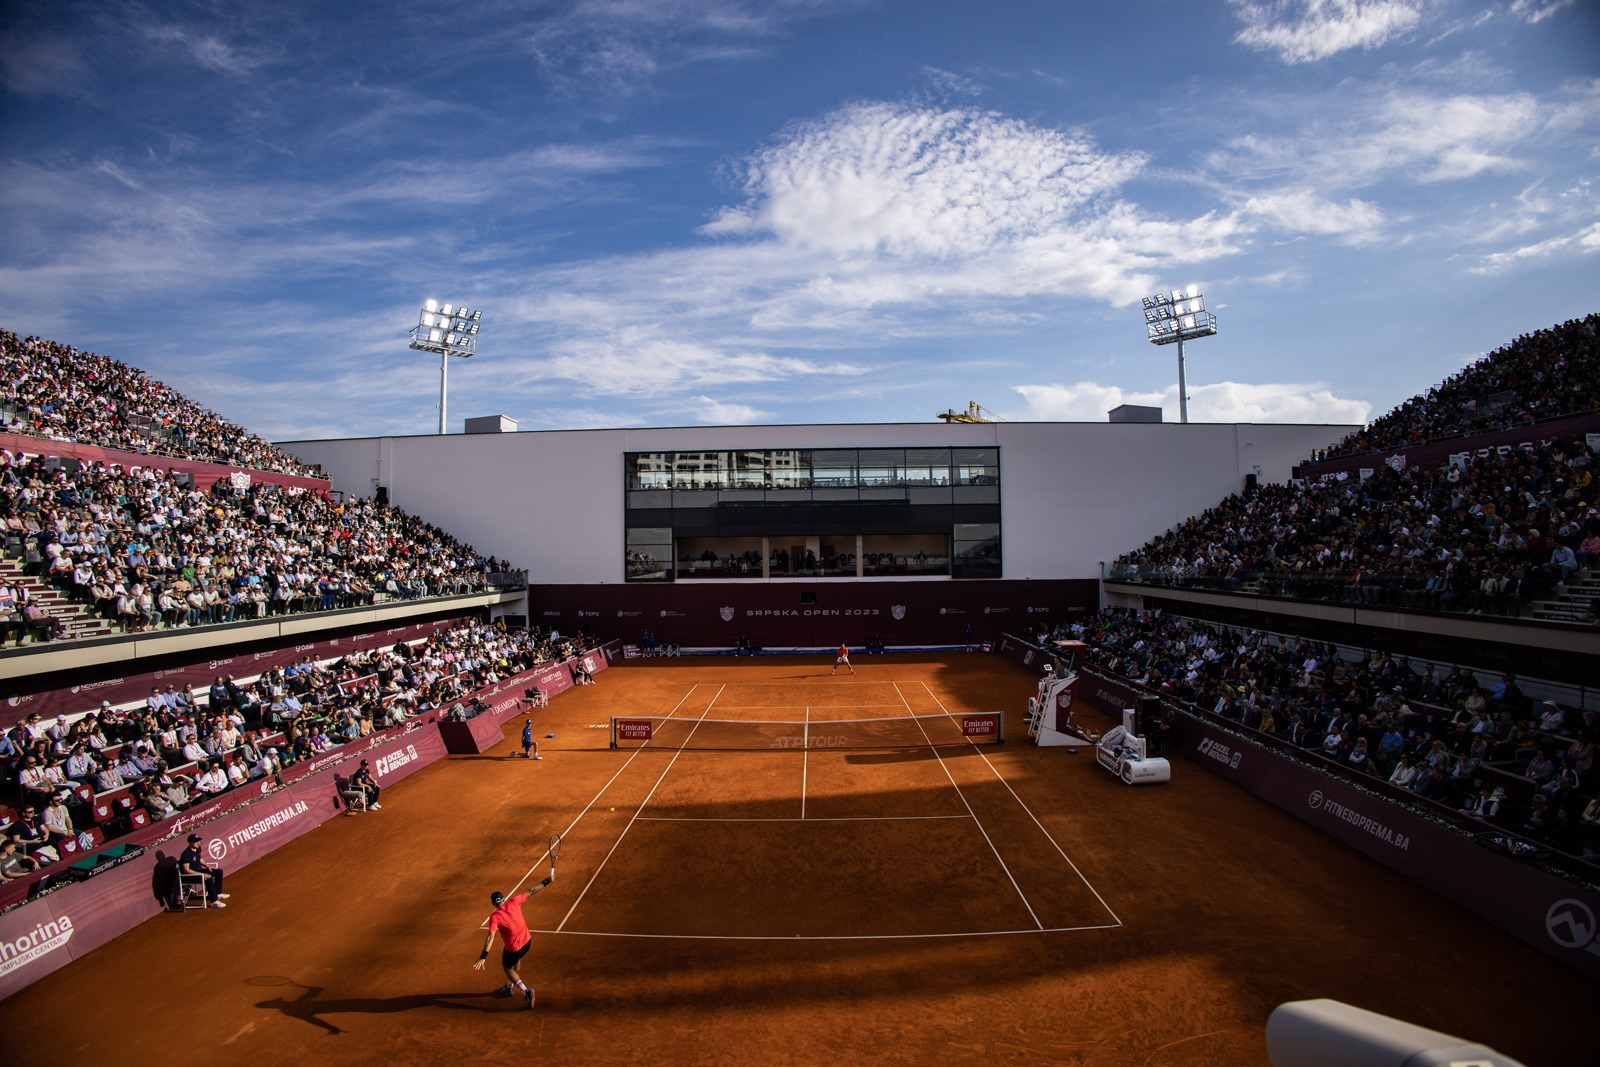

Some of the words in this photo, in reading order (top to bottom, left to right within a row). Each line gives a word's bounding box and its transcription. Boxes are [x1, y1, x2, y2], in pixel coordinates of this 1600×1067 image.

[770, 736, 804, 748] ATP
[808, 736, 848, 747] TOUR
[1213, 742, 1231, 755] DIZEL
[387, 749, 404, 763] DIZEL
[389, 754, 410, 771] BENZIN
[1207, 749, 1231, 765] BENZIN
[228, 801, 308, 848] FITNESOPREMA.BA
[1324, 799, 1410, 850] FITNESOPREMA.BA
[121, 848, 143, 862] zepter
[92, 859, 116, 874] zepter
[0, 915, 72, 964] horina
[0, 952, 34, 973] IMPIJSKI
[35, 937, 62, 955] CENTAR
